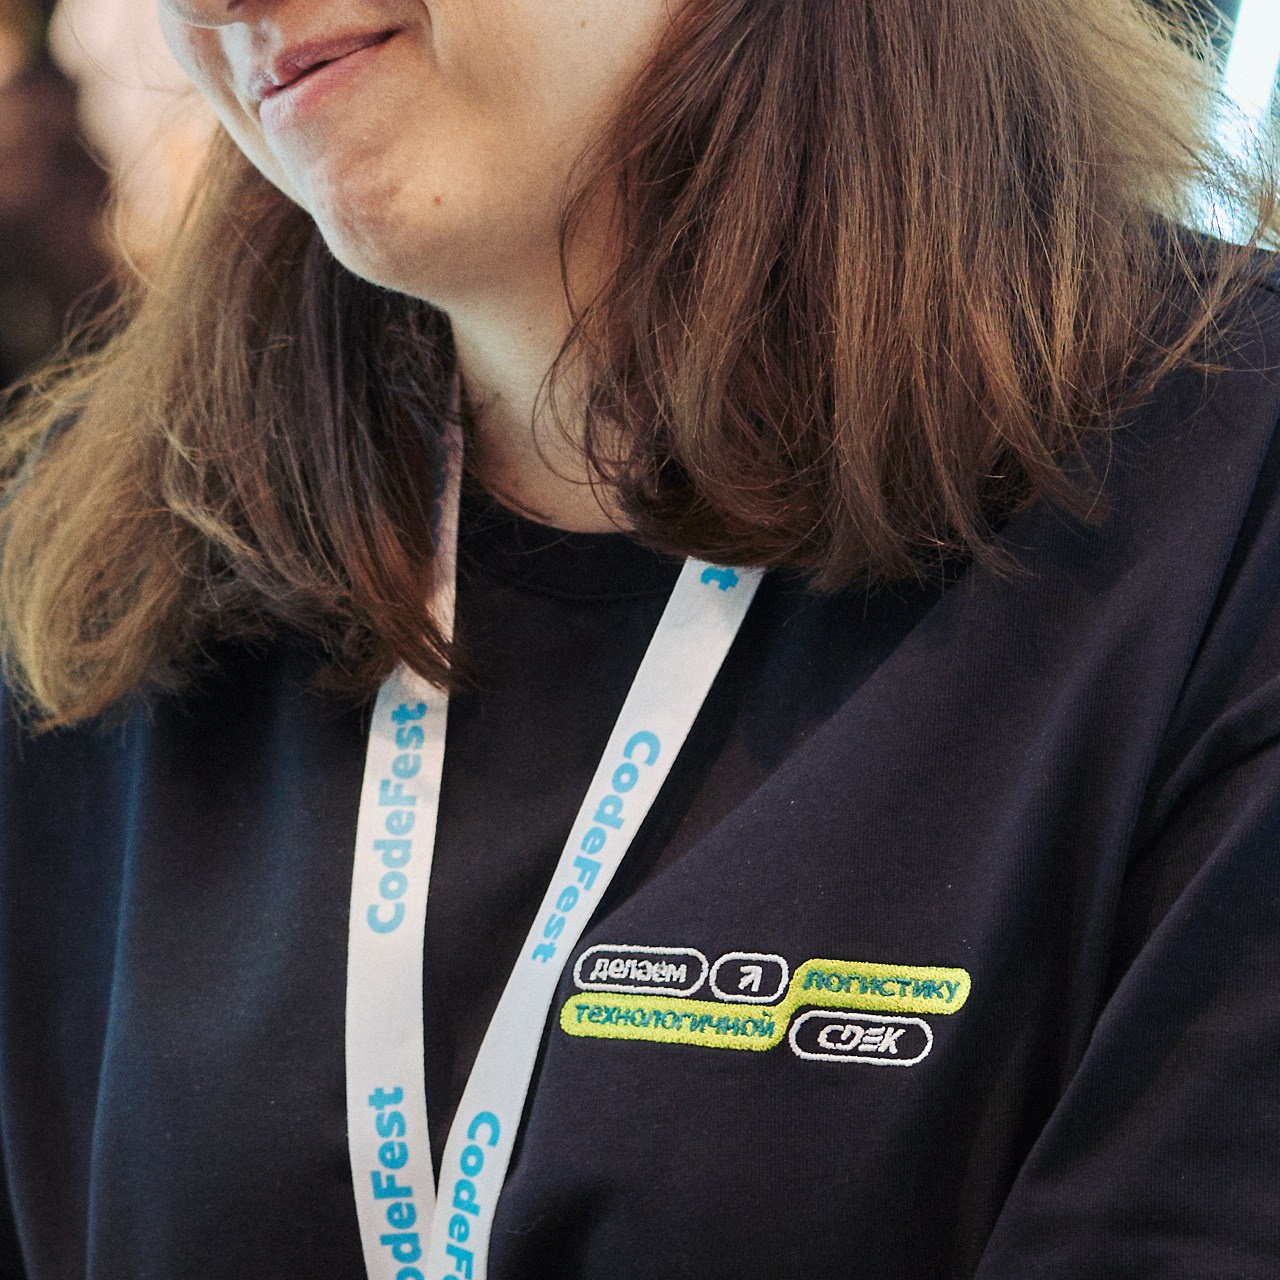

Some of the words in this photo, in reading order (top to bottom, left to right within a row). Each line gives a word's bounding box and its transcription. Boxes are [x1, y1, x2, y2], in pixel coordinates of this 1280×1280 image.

[366, 701, 428, 934] CodeFest
[531, 729, 662, 964] CodeFest
[575, 1003, 776, 1038] технологичной
[802, 969, 961, 1004] логистику
